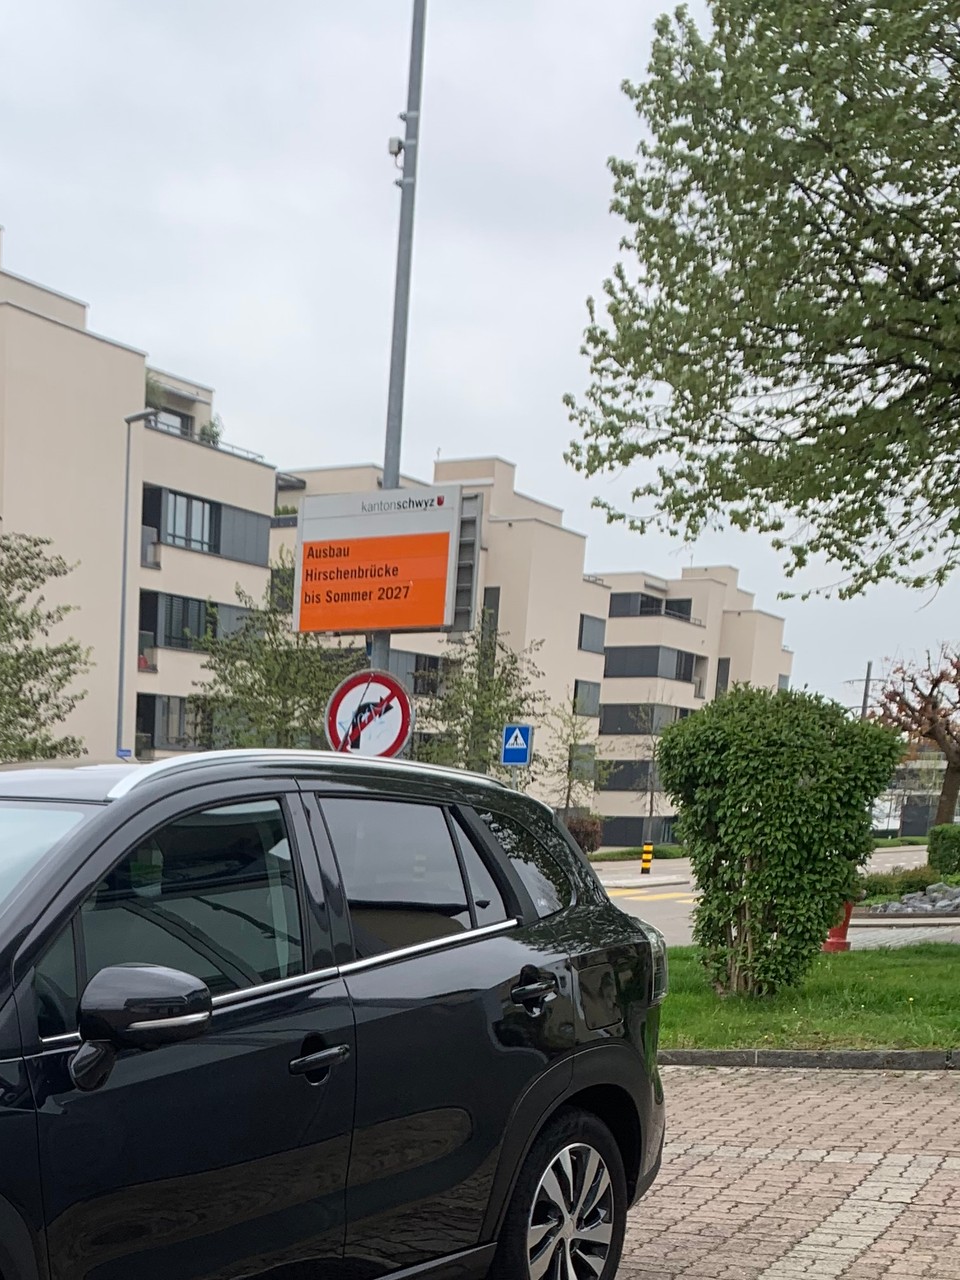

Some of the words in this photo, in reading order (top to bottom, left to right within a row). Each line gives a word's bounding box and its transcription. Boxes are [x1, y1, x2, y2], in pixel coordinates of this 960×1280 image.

[361, 497, 434, 513] kantonschwyz
[307, 545, 350, 559] Ausbau
[305, 564, 399, 581] Hirschenbrücke
[304, 590, 321, 605] bis
[325, 590, 373, 603] Sommer
[377, 585, 410, 600] 2027
